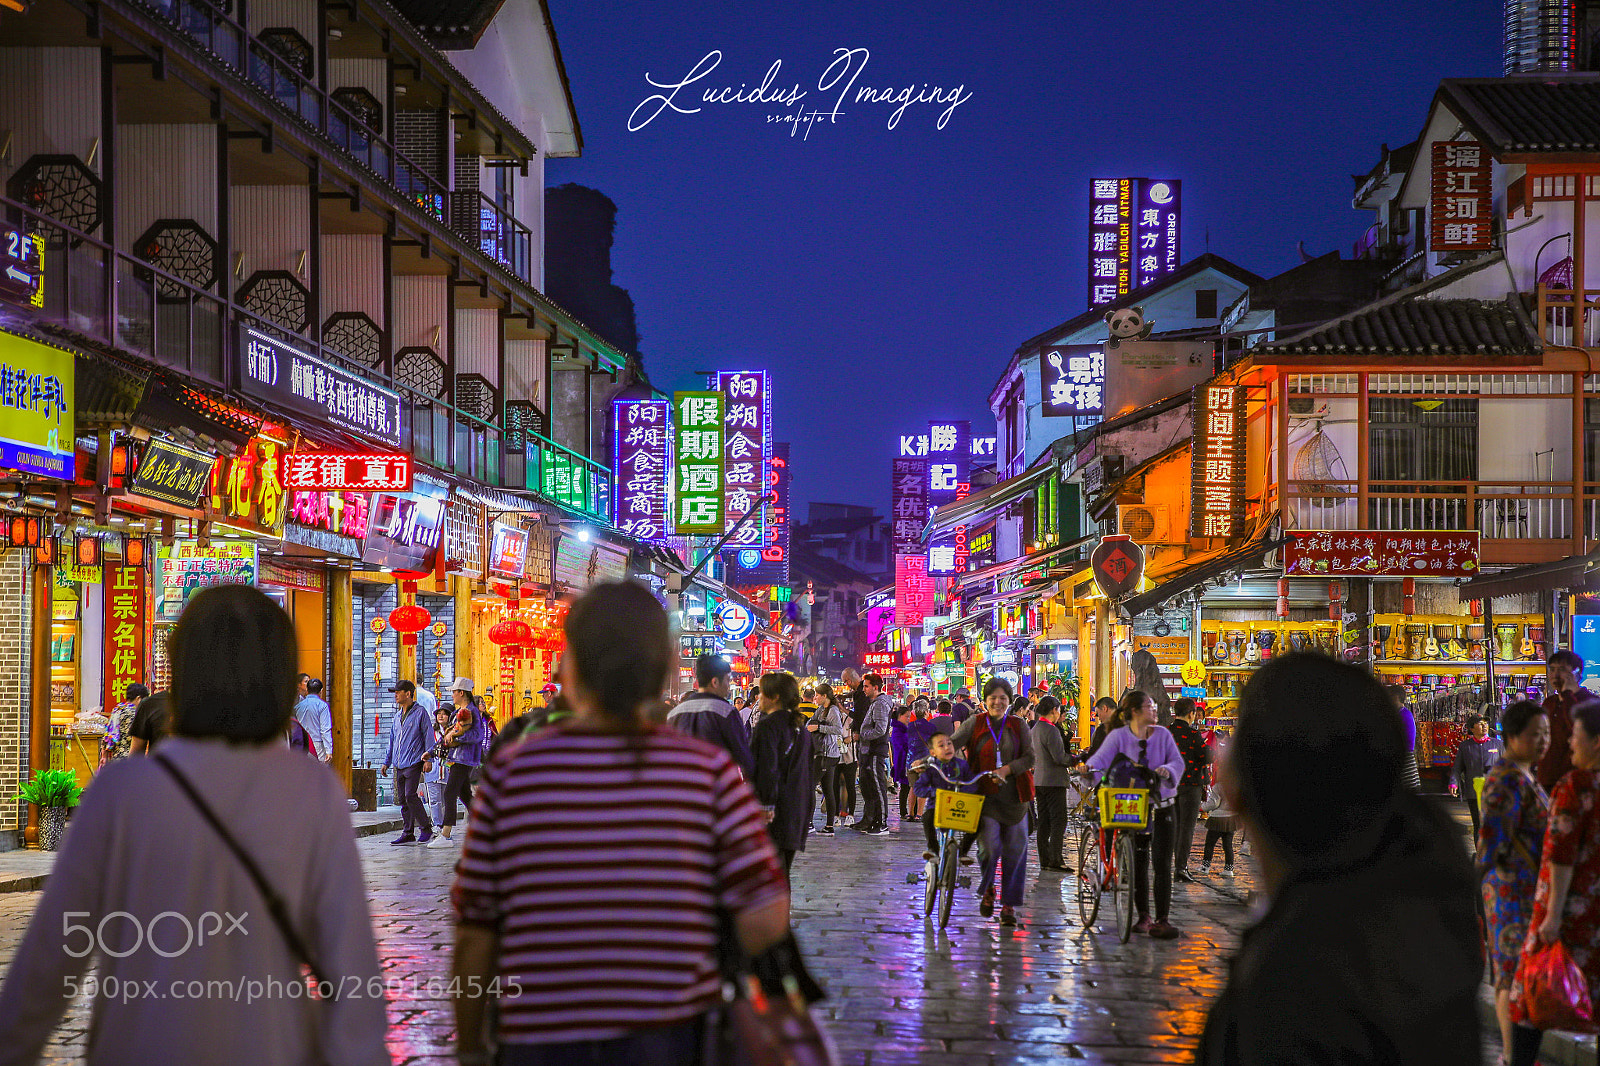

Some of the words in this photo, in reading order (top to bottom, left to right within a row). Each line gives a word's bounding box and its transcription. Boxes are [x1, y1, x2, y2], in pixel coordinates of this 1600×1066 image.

[1445, 145, 1480, 244] 漓江河鲜
[8, 231, 32, 261] 2F
[1140, 208, 1160, 285] 東方客
[1050, 380, 1102, 410] 女孩
[291, 458, 346, 486] 老铺
[620, 404, 660, 540] 阳朔食品商场
[679, 397, 719, 526] 假期酒店
[722, 374, 760, 545] 阳朔食品商场
[929, 424, 958, 573] 勝記庫
[1293, 538, 1377, 551] 正宗桂林米粉
[1385, 538, 1472, 551] 阳朔特色小炒
[162, 559, 246, 572] 真正正宗特产
[1110, 557, 1127, 576] 酒
[1430, 557, 1459, 570] 油条
[1186, 665, 1204, 681] 鼓
[1115, 800, 1139, 814] 出租
